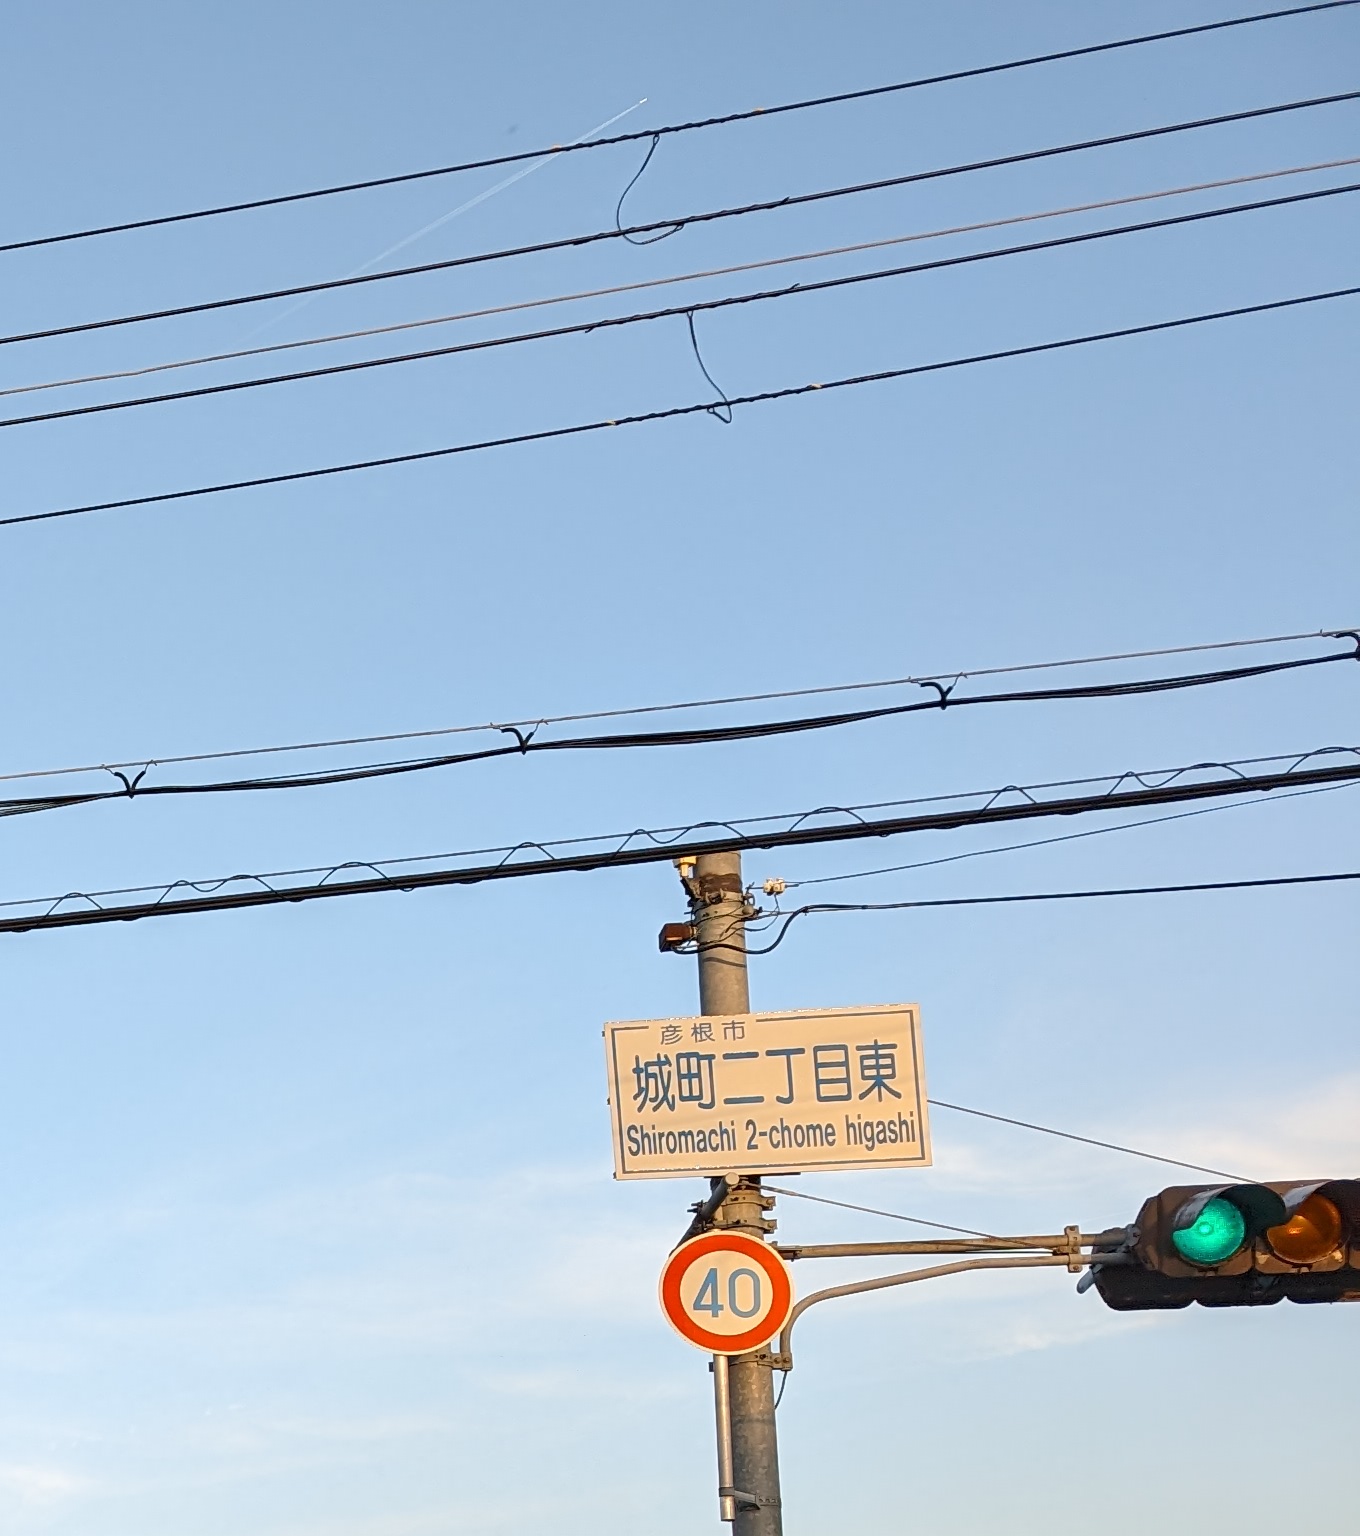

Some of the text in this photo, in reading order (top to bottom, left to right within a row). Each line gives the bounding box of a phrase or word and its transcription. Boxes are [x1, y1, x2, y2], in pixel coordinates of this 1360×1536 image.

[660, 1020, 746, 1046] 彦根市
[631, 1039, 903, 1113] 城町二丁目東
[627, 1110, 917, 1157] Shiromachi 2-chome higashi
[692, 1267, 762, 1319] 40
